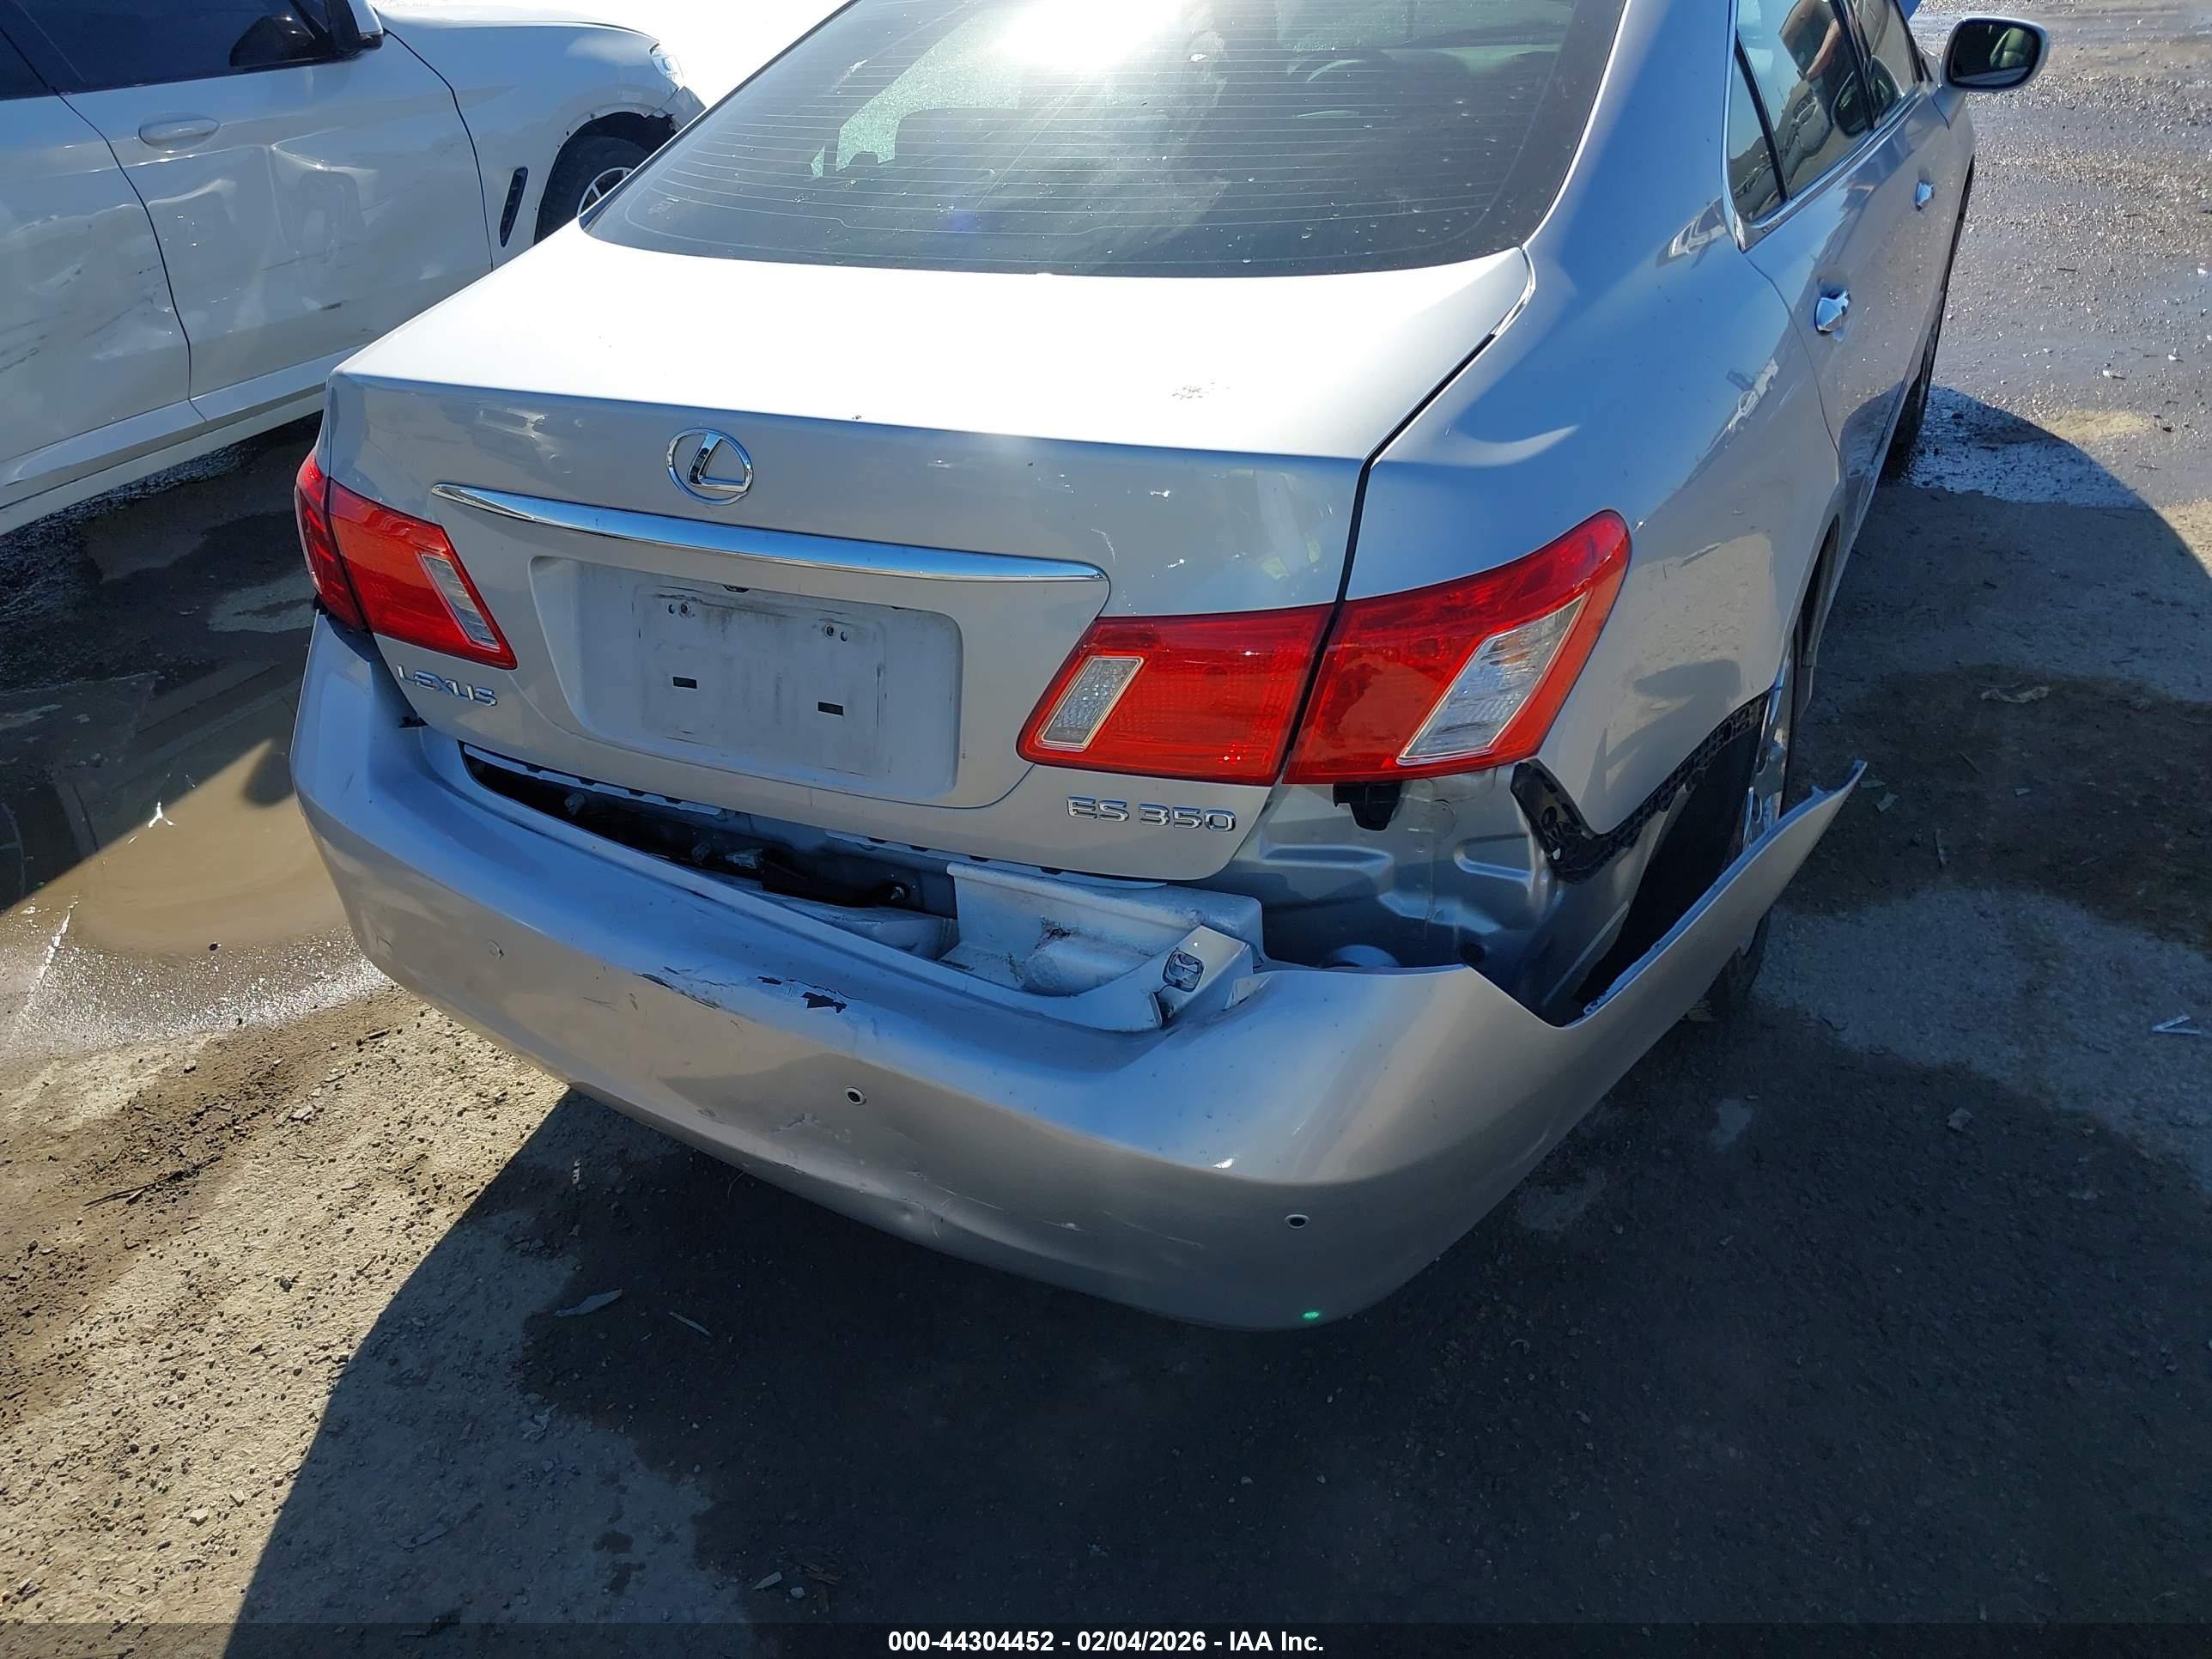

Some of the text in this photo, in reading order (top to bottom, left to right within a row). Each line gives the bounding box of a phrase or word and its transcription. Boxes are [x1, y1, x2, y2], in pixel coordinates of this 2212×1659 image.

[398, 664, 497, 707] LEXUS
[1066, 796, 1237, 832] ES 350
